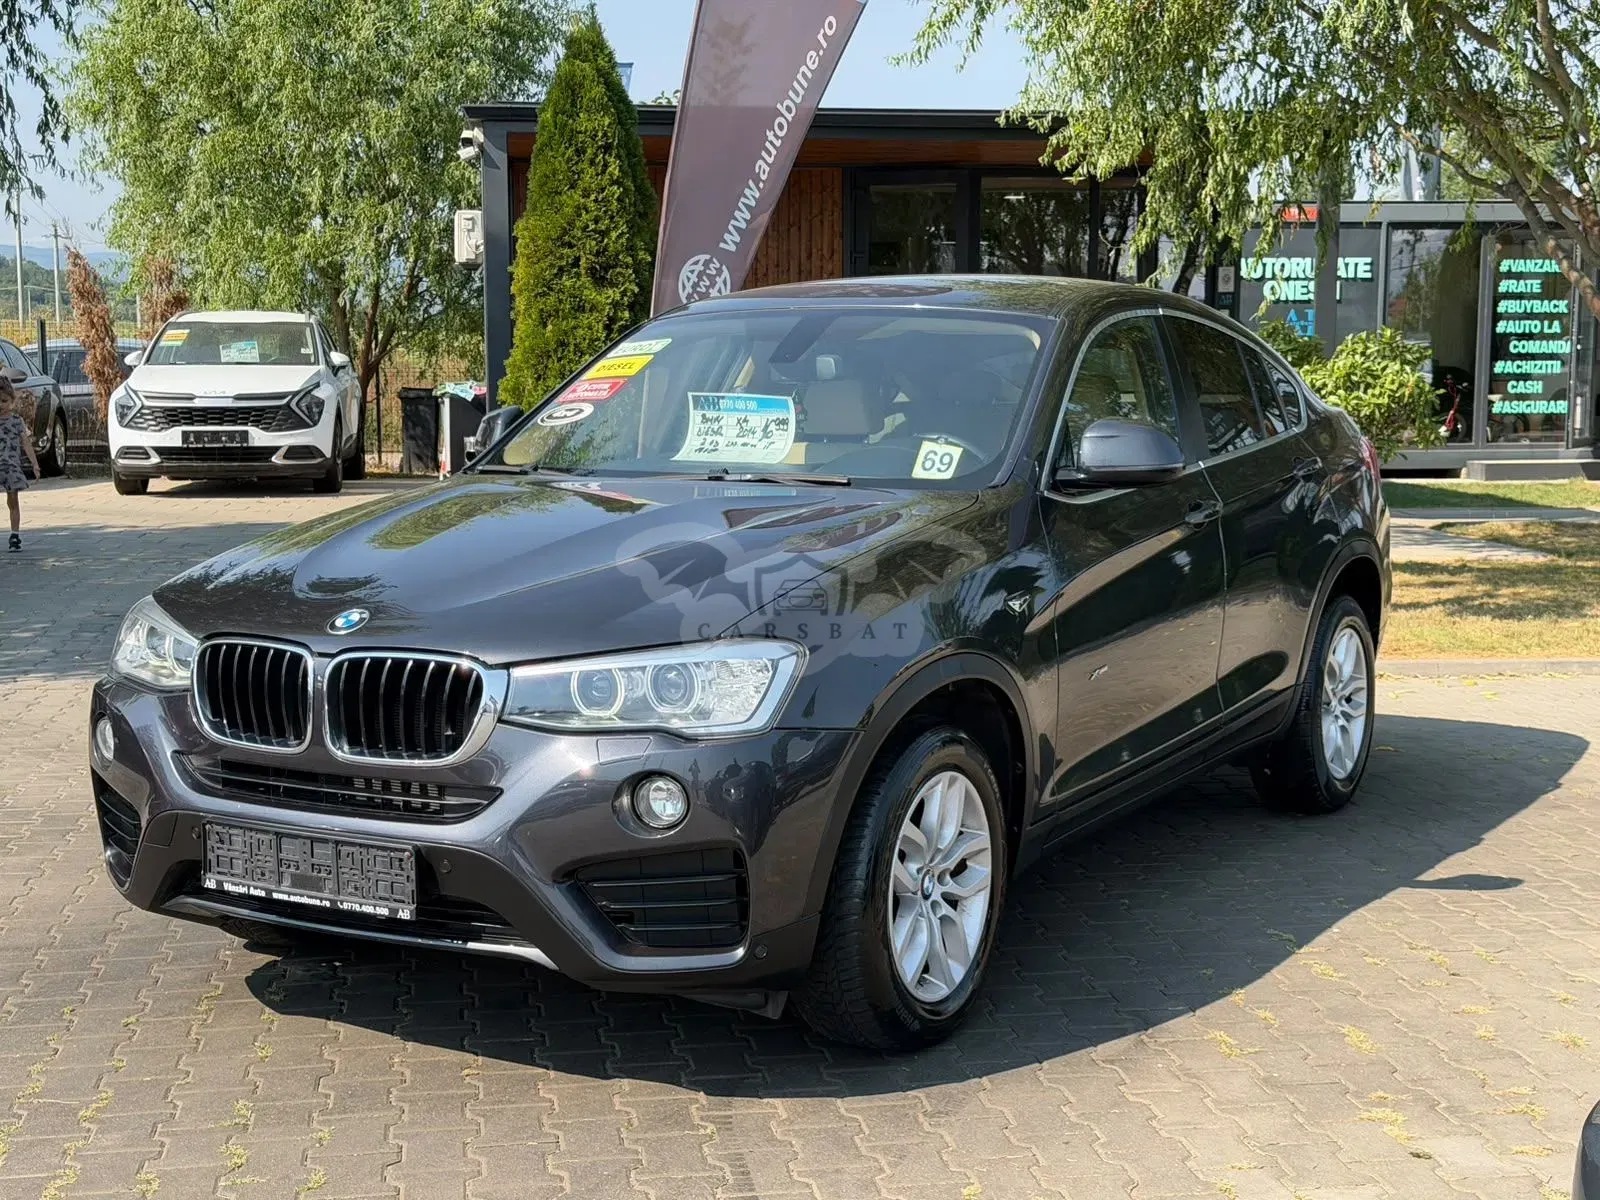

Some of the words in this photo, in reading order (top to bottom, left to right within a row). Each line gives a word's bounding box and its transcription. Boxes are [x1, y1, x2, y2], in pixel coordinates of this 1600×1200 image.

[719, 15, 838, 252] www.autobune.ro
[1498, 279, 1542, 293] #RATE
[1497, 300, 1569, 313] #BUYBACK
[1495, 320, 1541, 334] #AUTO
[1543, 320, 1561, 334] LA
[596, 362, 634, 373] DIESEL
[1507, 380, 1543, 394] CASH
[921, 450, 954, 473] 69
[204, 878, 216, 889] AB
[249, 887, 266, 897] Auto
[271, 891, 331, 907] www.autobune.ro
[397, 909, 411, 920] AB
